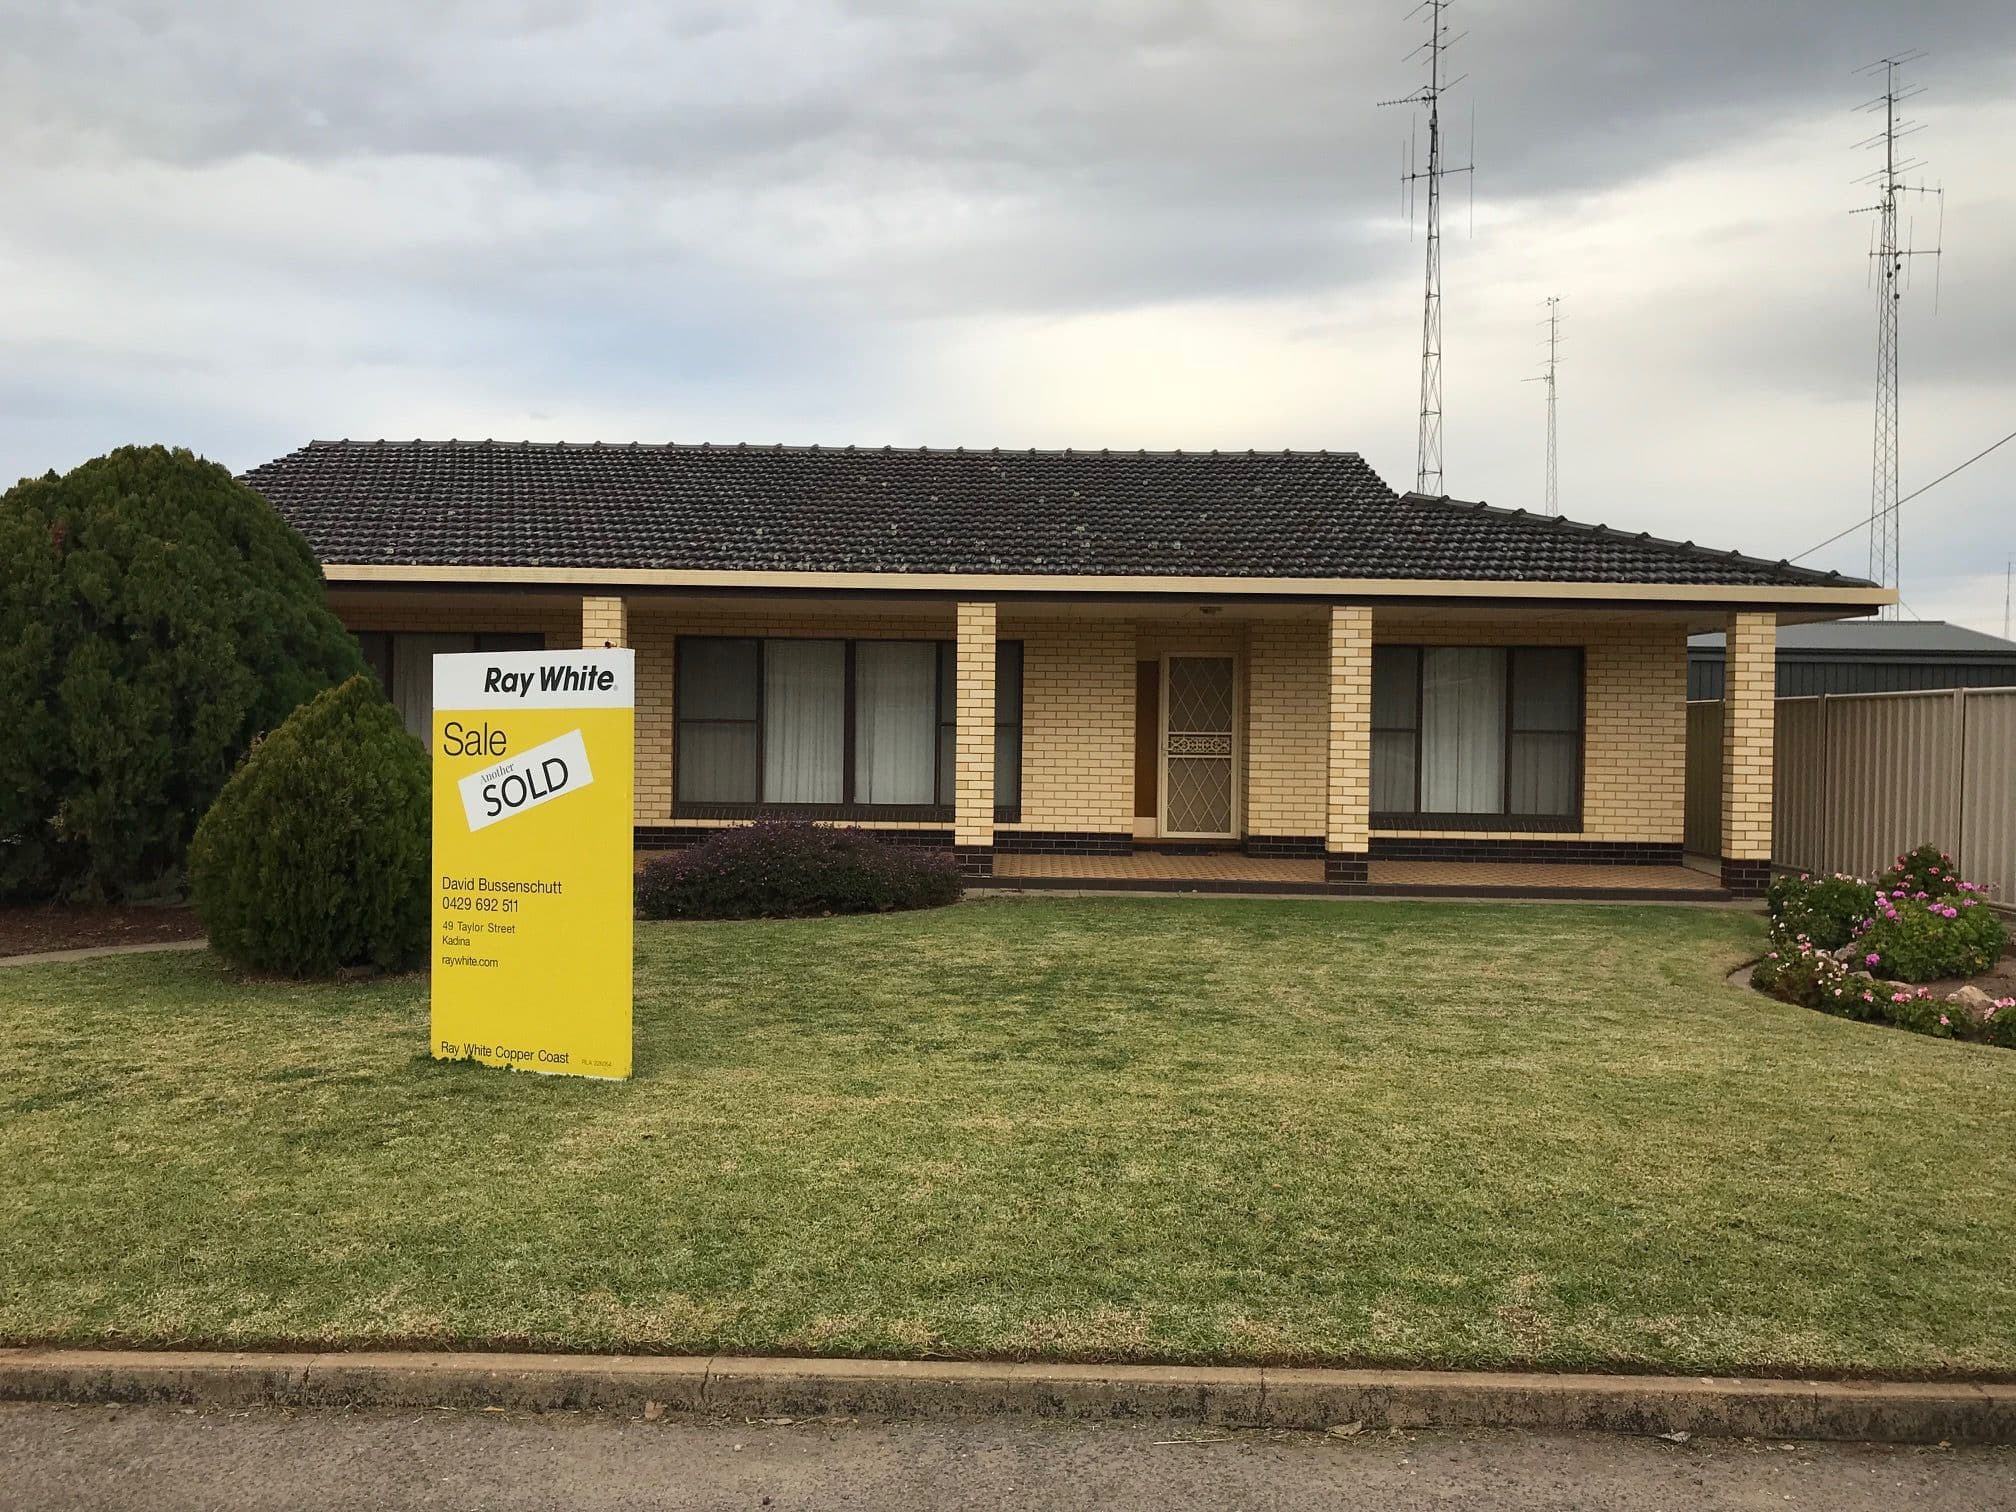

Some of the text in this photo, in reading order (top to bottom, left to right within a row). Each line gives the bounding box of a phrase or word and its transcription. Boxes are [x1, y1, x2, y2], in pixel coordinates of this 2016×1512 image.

[484, 665, 614, 697] Ray White
[444, 722, 507, 756] Sale
[480, 763, 515, 784] Another
[483, 758, 568, 817] SOLD
[442, 876, 562, 894] David Bussenschutt
[442, 896, 519, 912] 0429 692 511
[442, 921, 515, 934] 49 Taylor Street
[442, 935, 470, 946] Kadina
[442, 955, 499, 967] raywhite.com
[441, 1041, 569, 1064] Ray White Copper Coast
